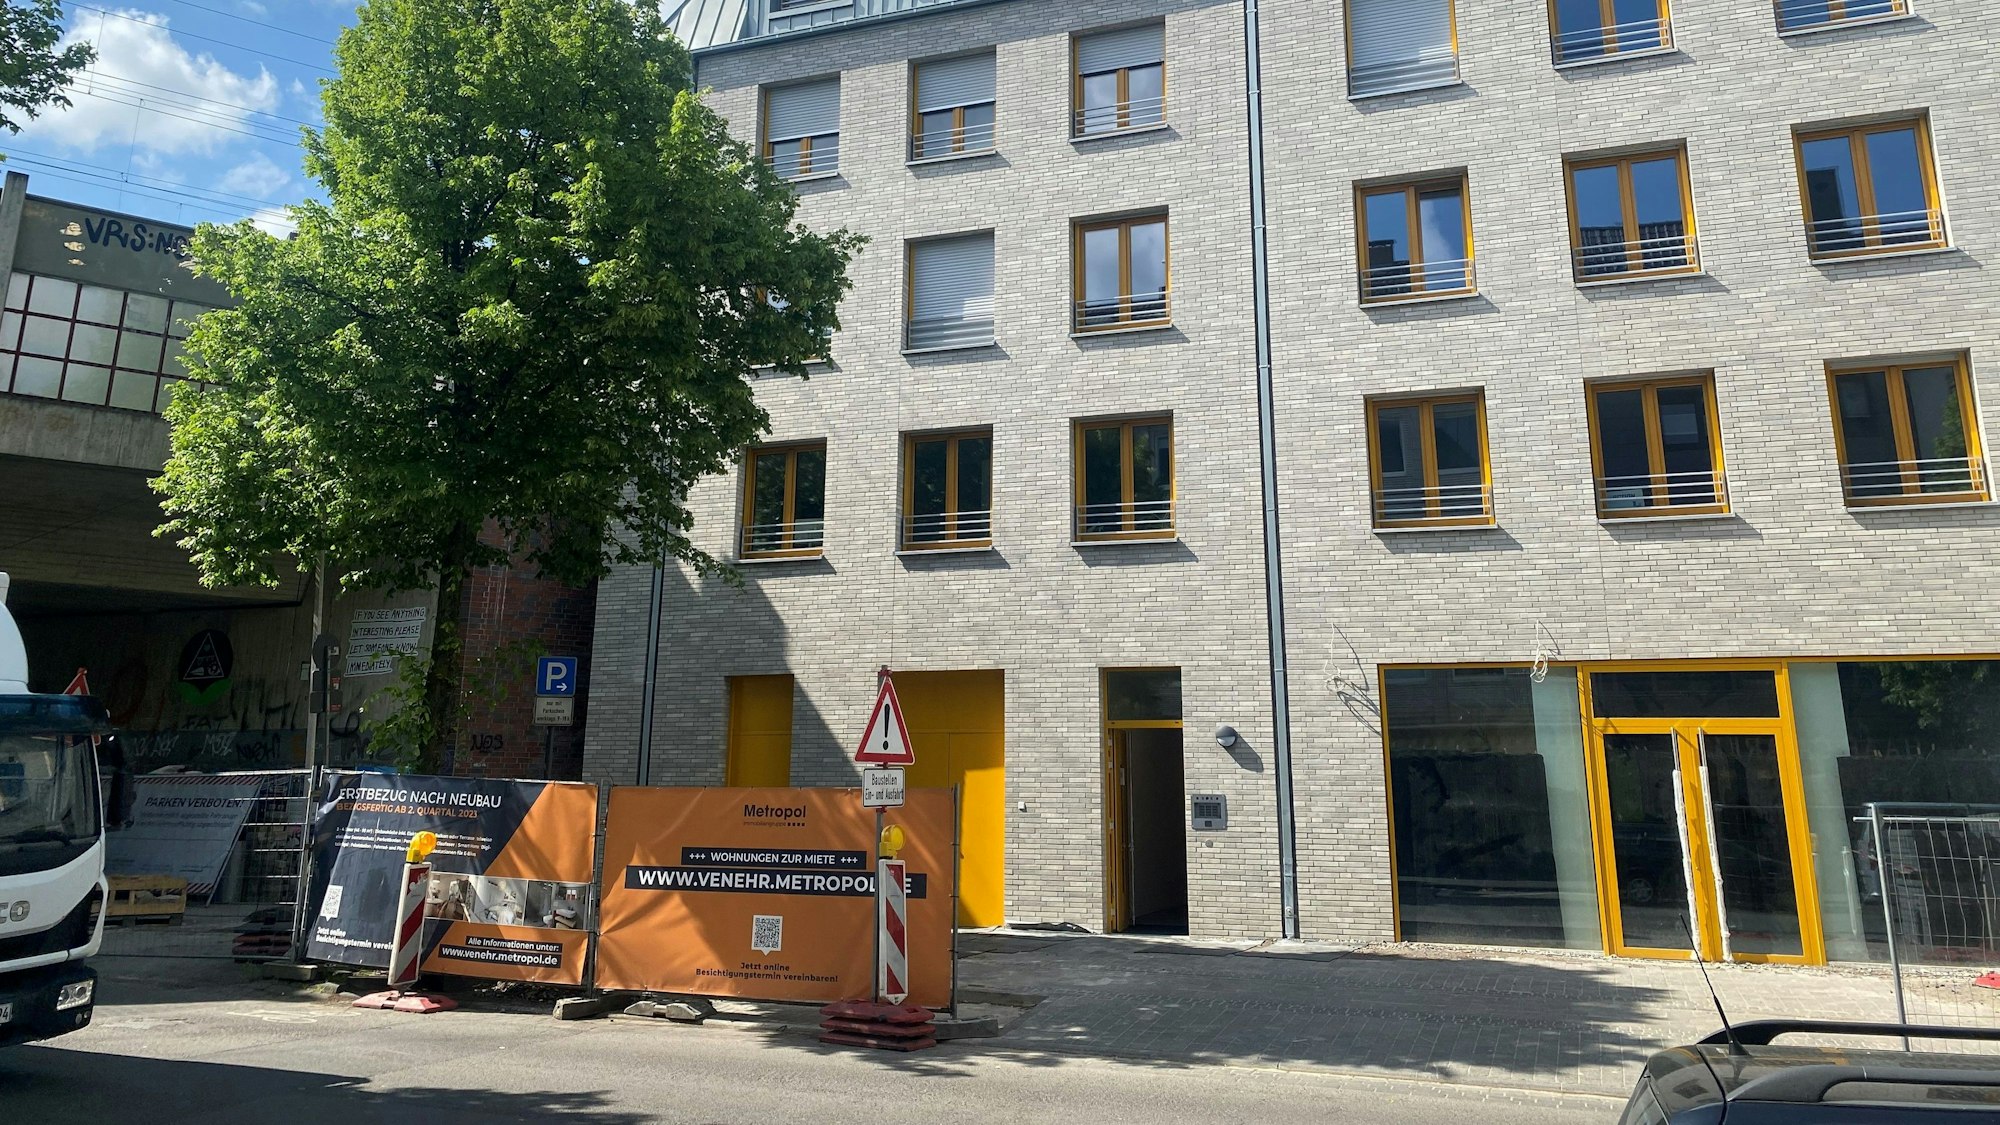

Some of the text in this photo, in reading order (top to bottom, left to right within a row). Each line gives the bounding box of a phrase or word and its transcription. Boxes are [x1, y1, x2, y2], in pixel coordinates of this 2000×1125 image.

[364, 610, 375, 620] YOU
[376, 610, 390, 620] SEE
[391, 608, 425, 619] ANYTHING
[351, 625, 420, 637] INTERESTING PLEASE
[349, 644, 364, 654] LET
[365, 643, 394, 653] SOMEONE
[346, 659, 391, 674] IMMEDATELY
[546, 662, 567, 690] P
[872, 773, 898, 786] Baustellen
[340, 787, 502, 808] ERSTBEZUG NACH NEUBAU
[875, 788, 884, 800] und
[885, 788, 904, 802] Ausfahrt
[145, 797, 244, 808] PARKEN VERBOTEN!
[394, 803, 407, 814] AB
[407, 805, 415, 815] 2.
[417, 807, 457, 818] QUARTAL
[459, 809, 478, 819] 2023
[744, 804, 806, 820] Metropol
[710, 852, 779, 863] WOHNUNGEN
[781, 853, 803, 864] ZUR
[804, 853, 836, 865] MIETE
[638, 869, 912, 894] WWW.VENEHR.METROPOLE
[317, 926, 347, 937] Jetzt online
[315, 934, 394, 950] Besichtigungstermin verein
[468, 937, 560, 952] Alle Informationen unter:
[442, 946, 558, 965] www.venehr.metropol.de
[740, 962, 790, 971] Jetzt online
[696, 968, 838, 982] Besichtigungstermin vereinbaren!
